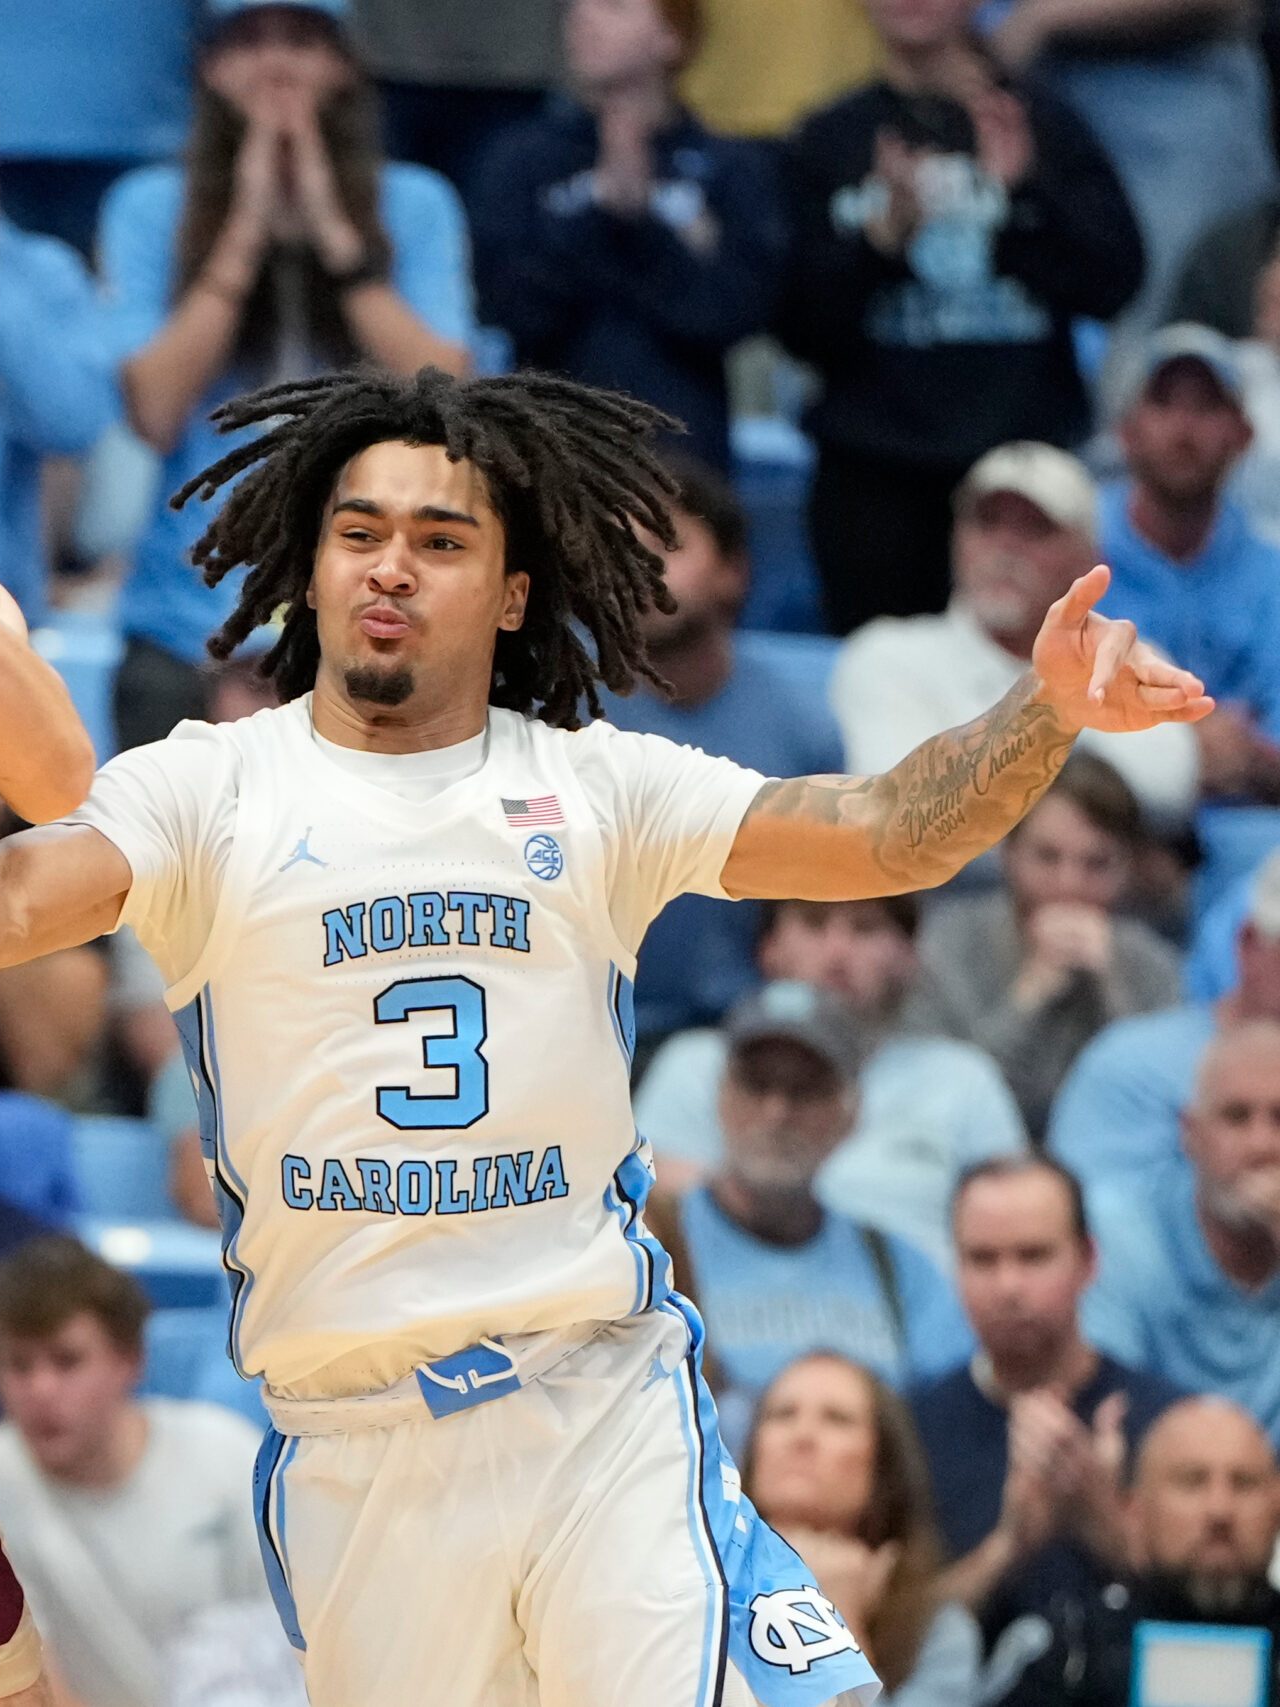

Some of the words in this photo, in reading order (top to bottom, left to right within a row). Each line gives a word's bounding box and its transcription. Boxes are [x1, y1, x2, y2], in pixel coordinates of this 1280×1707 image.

[934, 807, 967, 841] 2004
[322, 891, 531, 968] NORTH
[373, 974, 489, 1131] 3
[281, 1145, 570, 1216] CAROLINA
